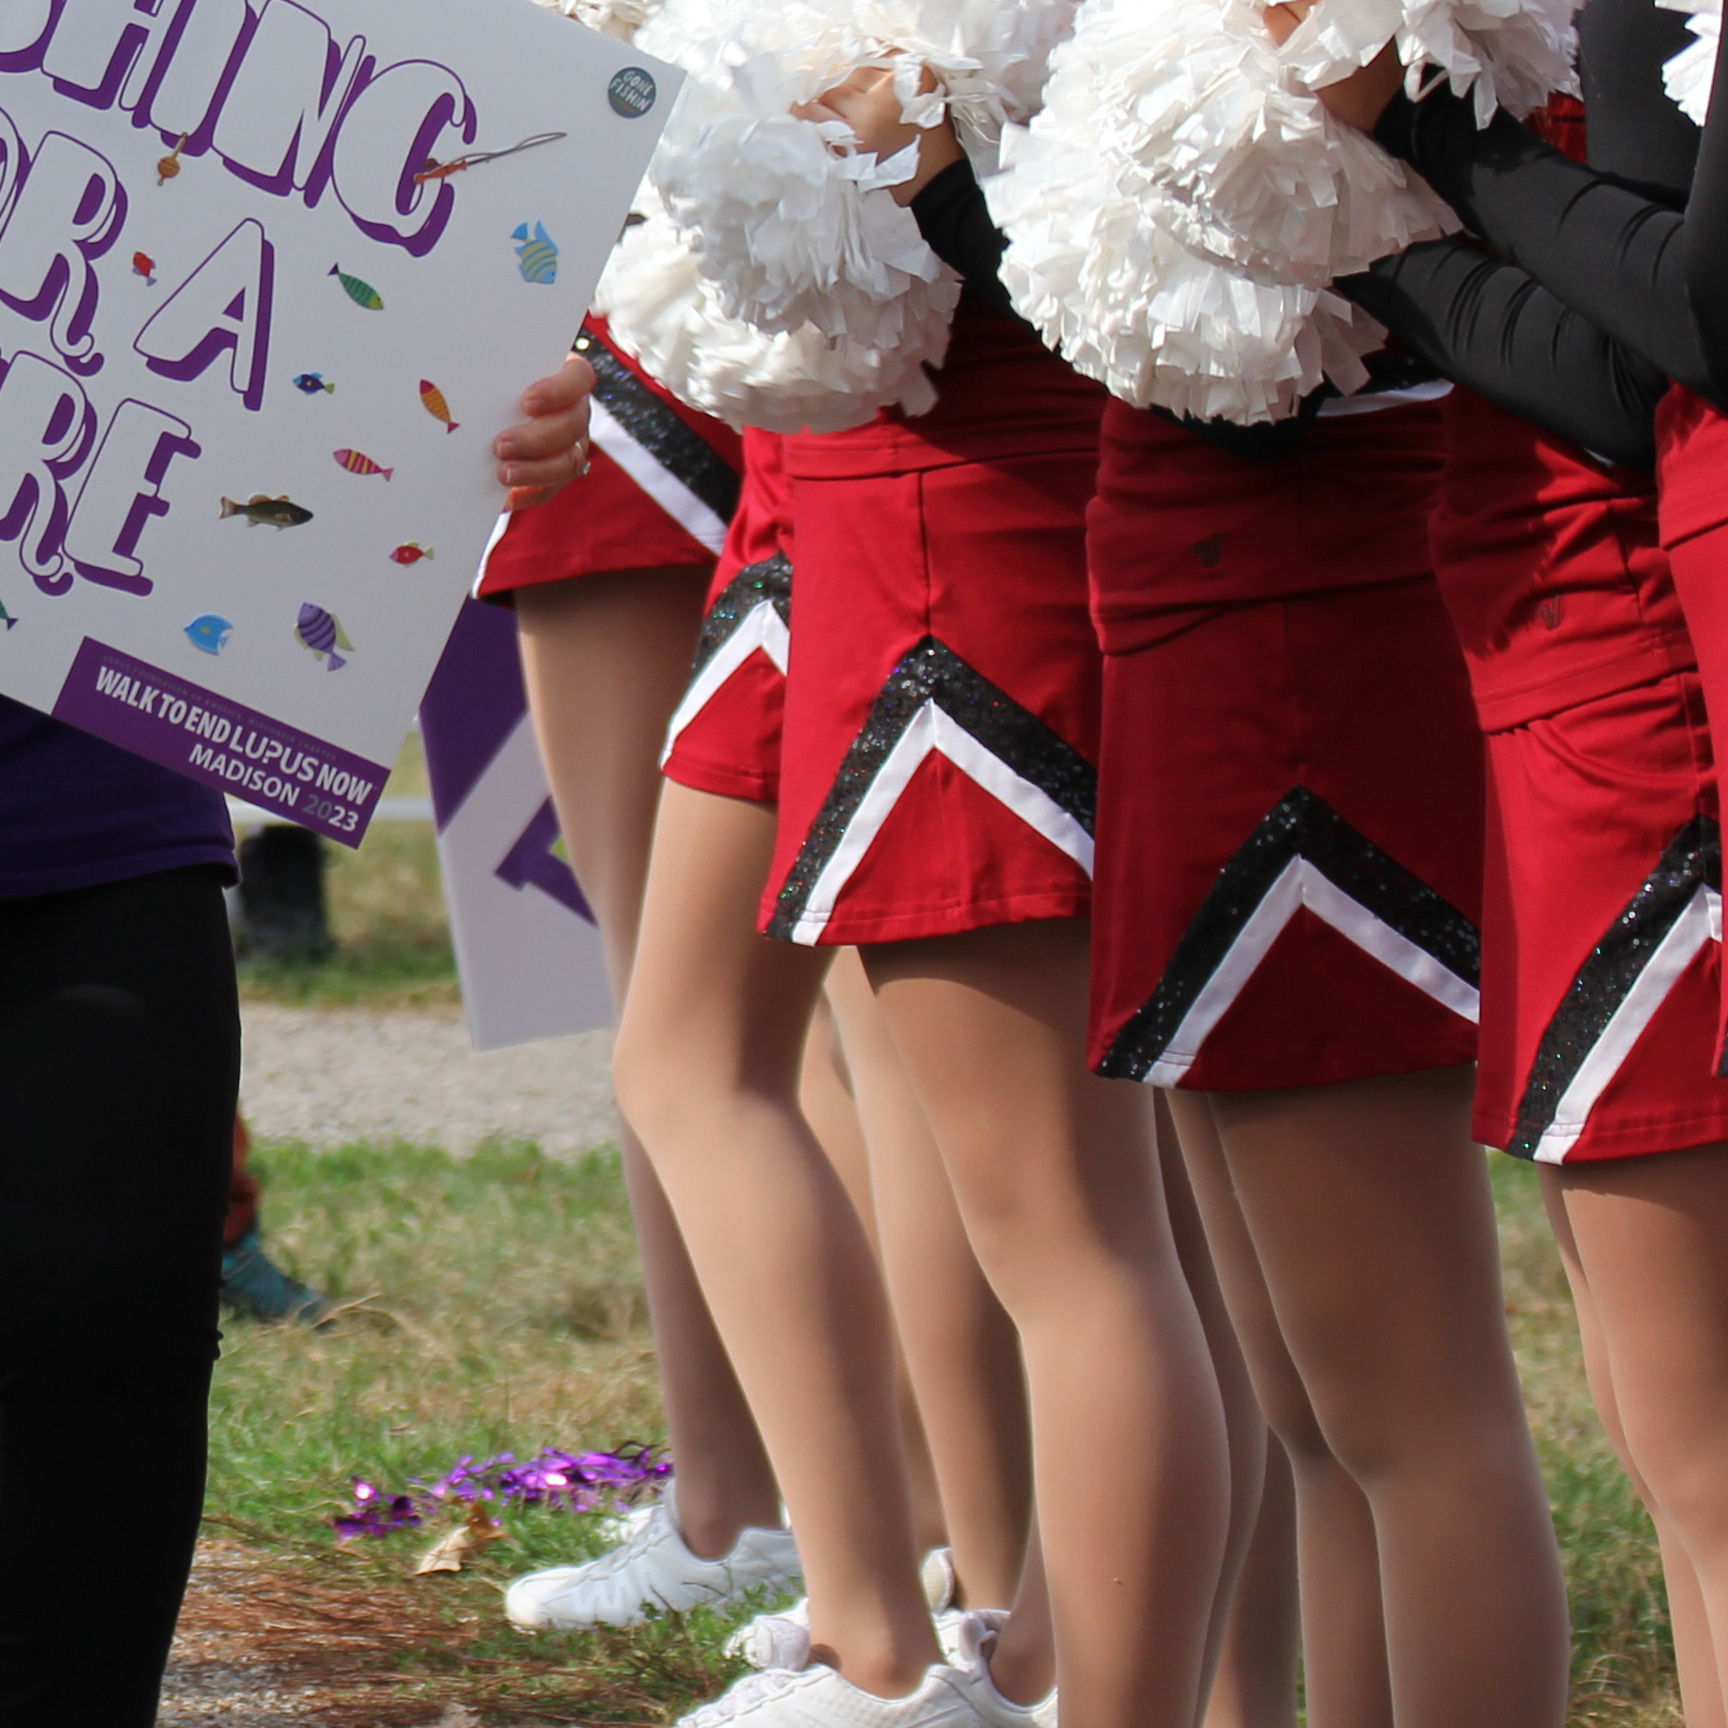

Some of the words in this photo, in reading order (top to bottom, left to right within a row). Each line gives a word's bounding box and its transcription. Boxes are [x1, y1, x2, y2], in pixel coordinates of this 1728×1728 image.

[623, 70, 654, 96] GONE
[133, 217, 275, 410] A
[96, 665, 160, 714] WALK
[157, 692, 188, 725] TO
[184, 706, 232, 744] END
[315, 764, 373, 807] NOW
[189, 744, 301, 807] MADISON
[302, 794, 359, 833] 2023
